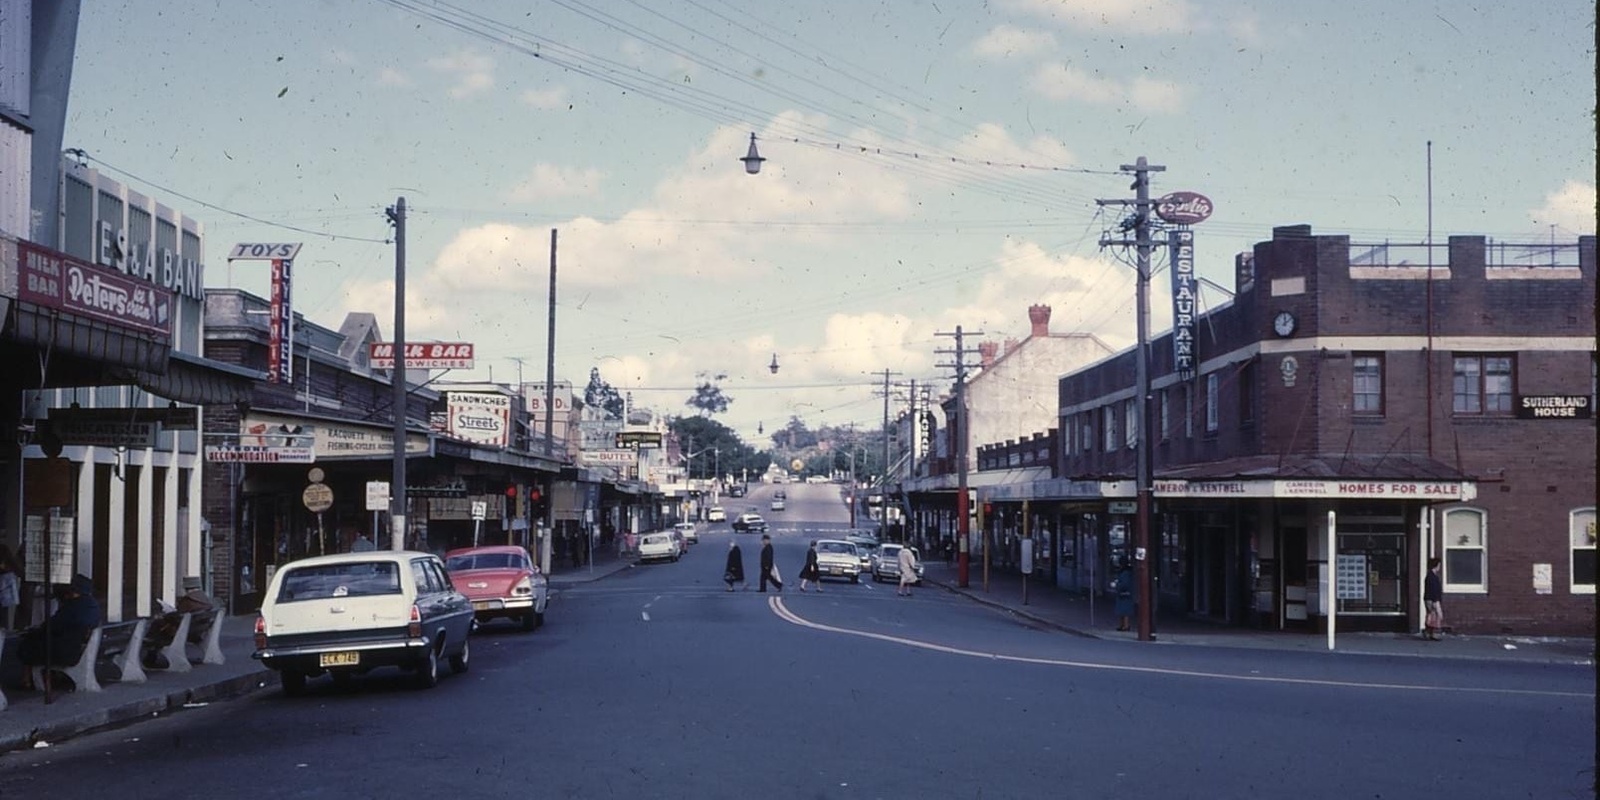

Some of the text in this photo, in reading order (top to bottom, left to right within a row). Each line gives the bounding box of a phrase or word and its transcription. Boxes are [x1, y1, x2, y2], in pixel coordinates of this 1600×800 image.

[237, 244, 293, 257] TOYS
[27, 251, 60, 276] MILK
[163, 247, 205, 300] BANK
[28, 273, 60, 298] BAR
[68, 266, 128, 316] Peters
[1177, 232, 1194, 368] RESTAURANT
[269, 263, 281, 384] SPORTS
[281, 261, 291, 381] CYCLES
[373, 345, 471, 358] MLK BAR
[379, 360, 466, 368] SADWICHES
[450, 394, 507, 406] SANDWICHES
[1522, 396, 1588, 408] SUTHERLAND
[1534, 407, 1576, 417] HOUSE
[458, 414, 500, 431] Streets
[209, 452, 279, 461] ACCOMMODATION
[1154, 483, 1190, 493] AMERON
[1201, 483, 1246, 493] KENTWELL
[1339, 483, 1458, 495] HOMES FOR SALE
